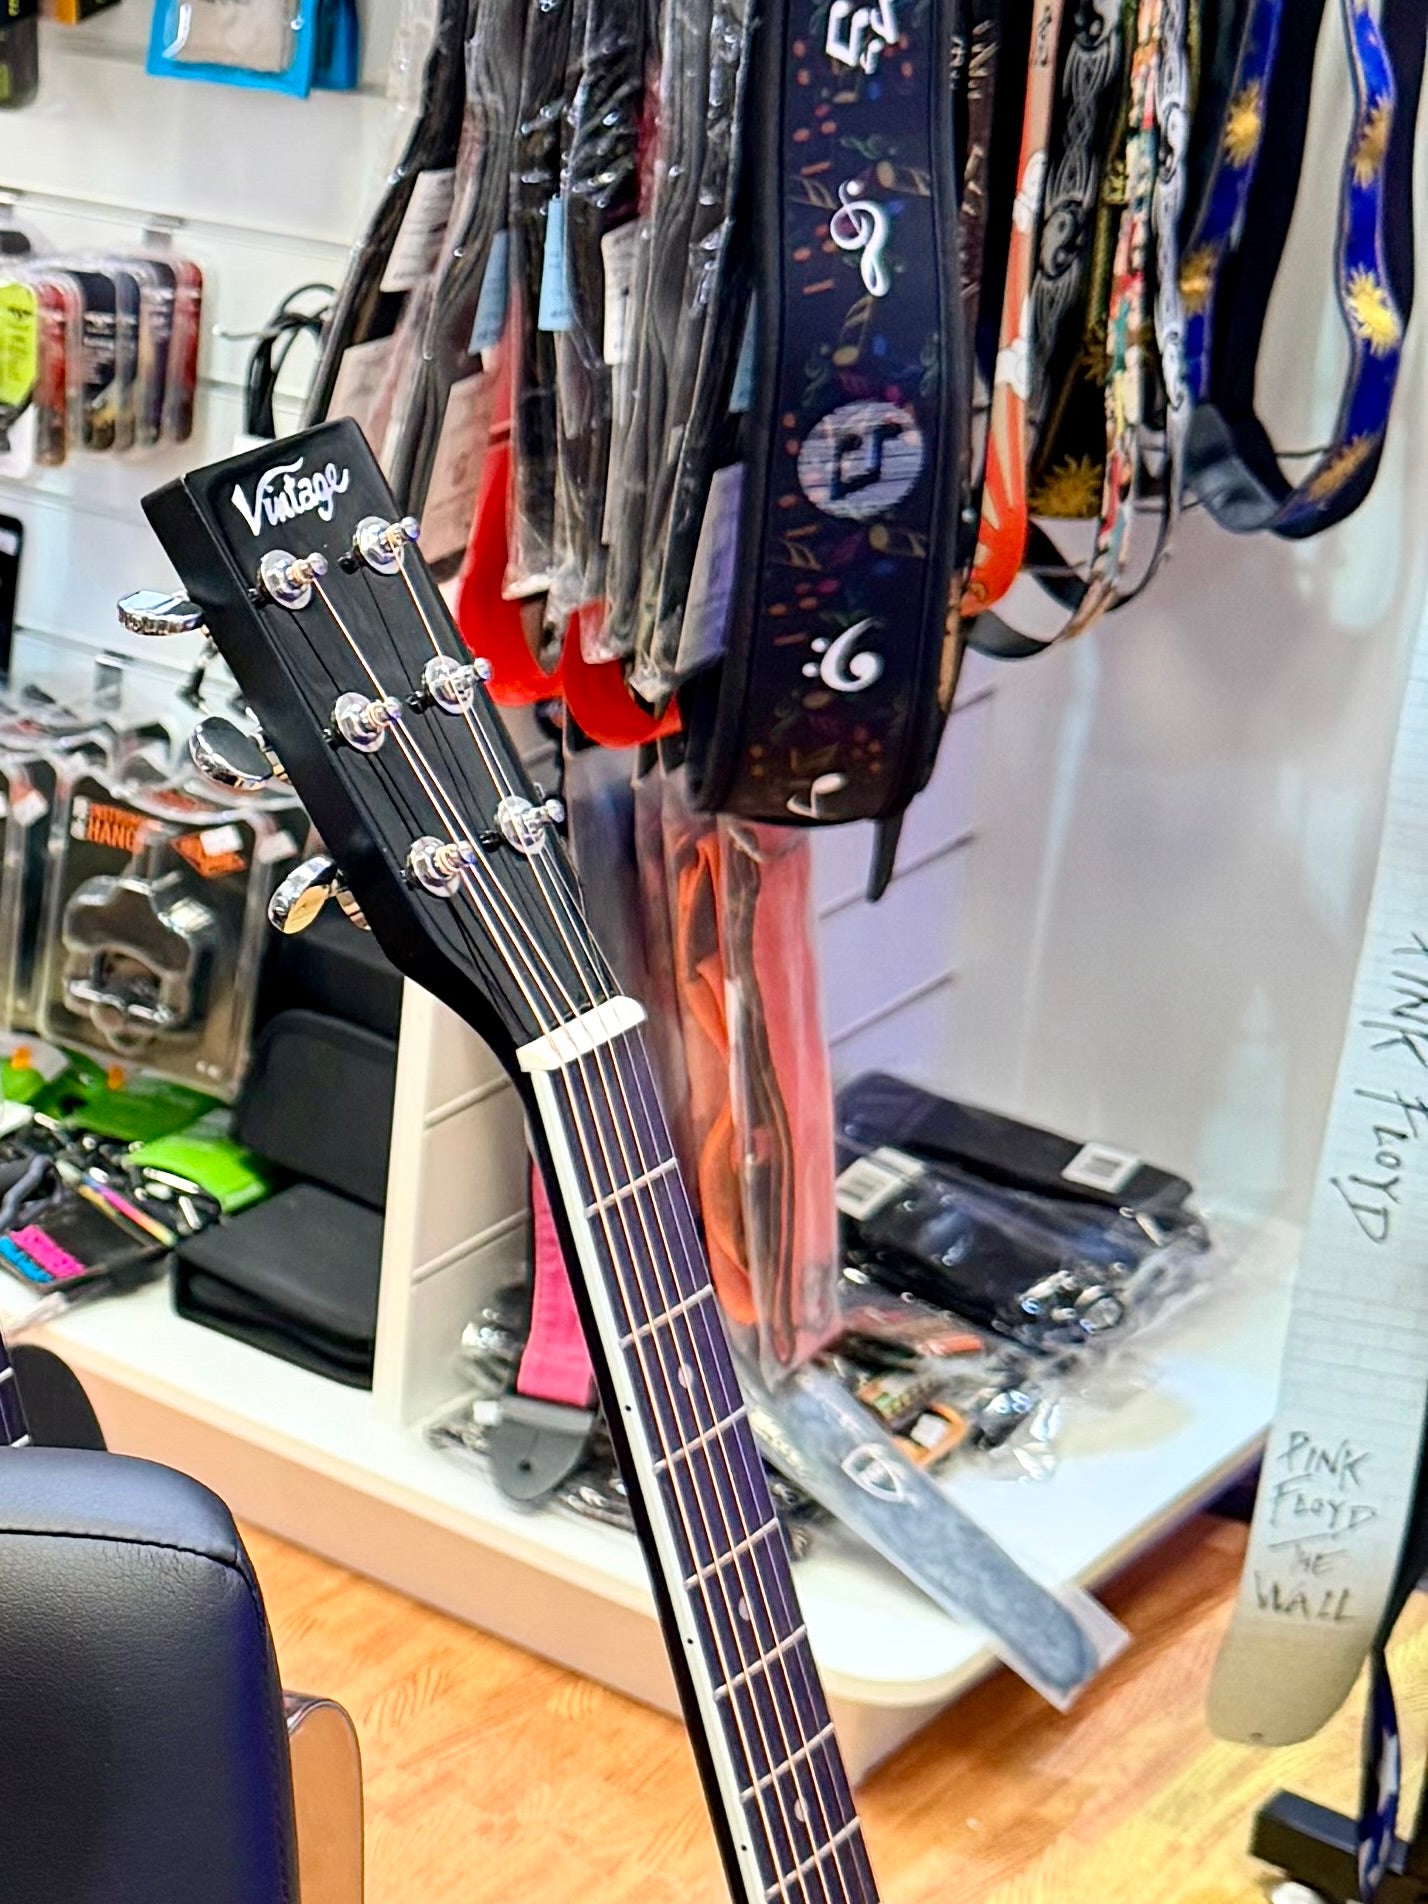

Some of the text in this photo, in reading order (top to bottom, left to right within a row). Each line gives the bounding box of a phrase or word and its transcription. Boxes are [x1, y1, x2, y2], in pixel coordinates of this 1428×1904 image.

[231, 456, 349, 536] Vintage
[1278, 1430, 1369, 1490] PINK
[1270, 1481, 1377, 1534] FLOYD
[1253, 1570, 1355, 1623] WALL
